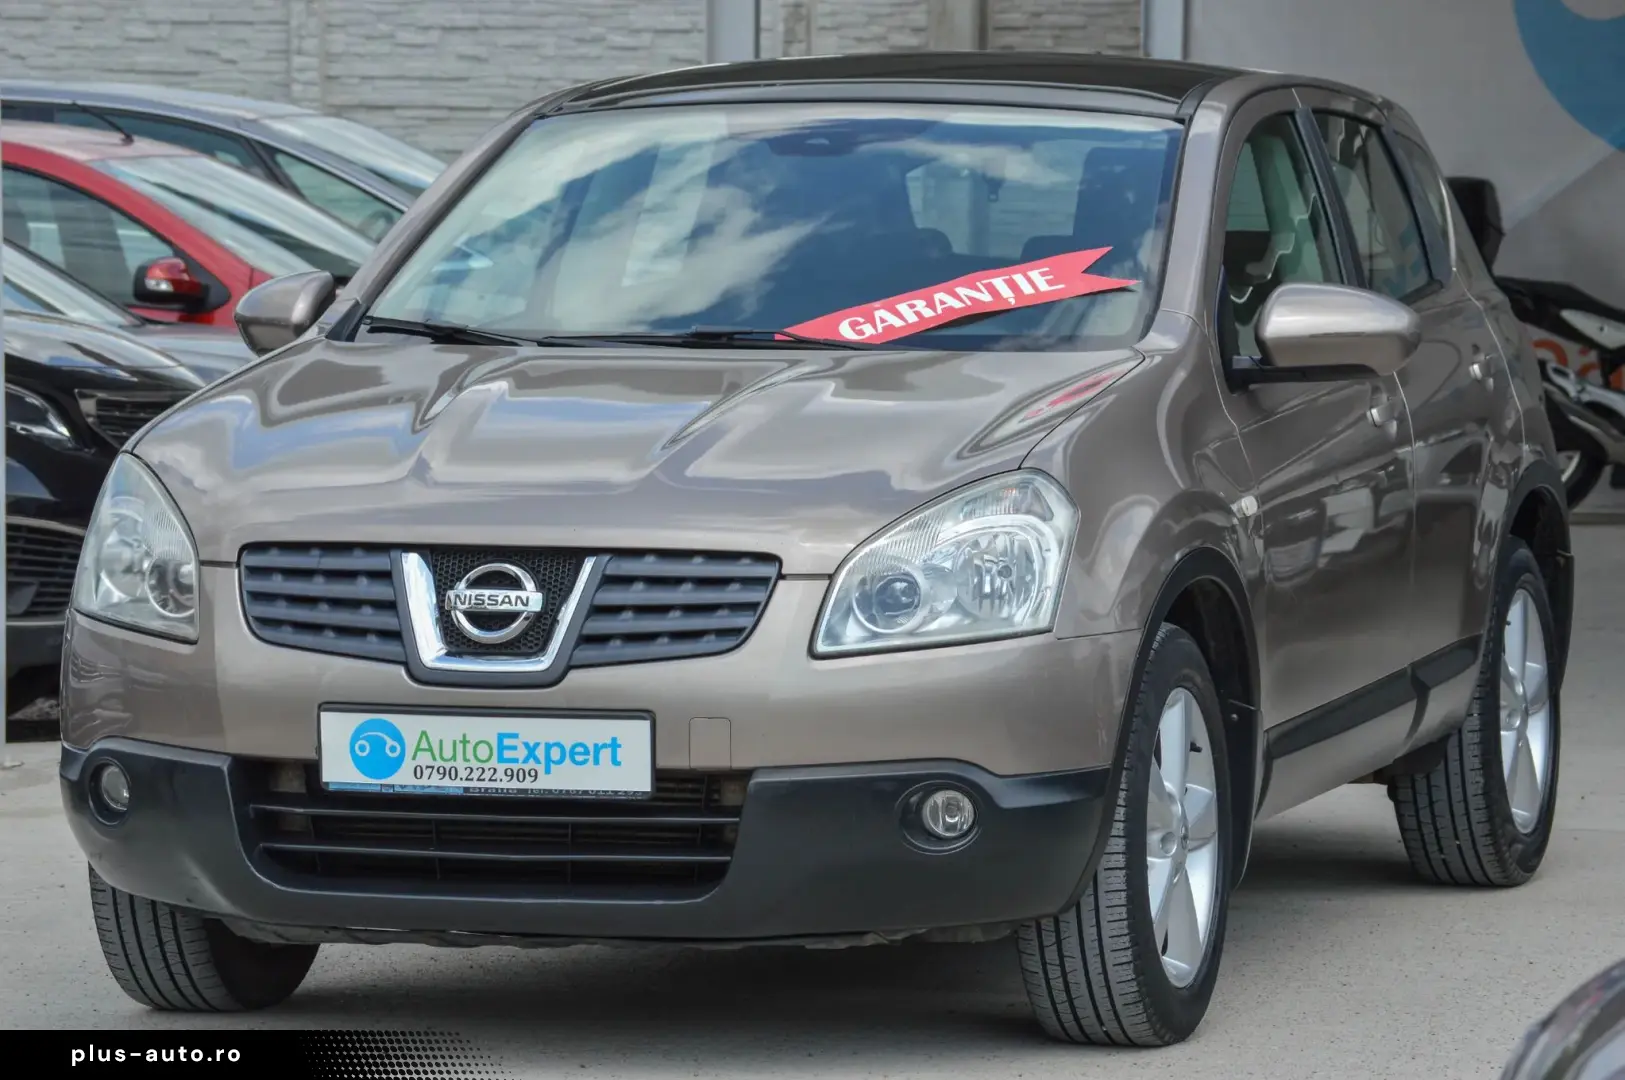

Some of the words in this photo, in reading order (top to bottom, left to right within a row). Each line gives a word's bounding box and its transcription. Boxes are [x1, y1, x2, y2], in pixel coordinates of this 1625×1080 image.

[453, 593, 530, 607] NISSAN
[411, 730, 622, 775] AutoExpert
[413, 765, 539, 783] 0790.222.909
